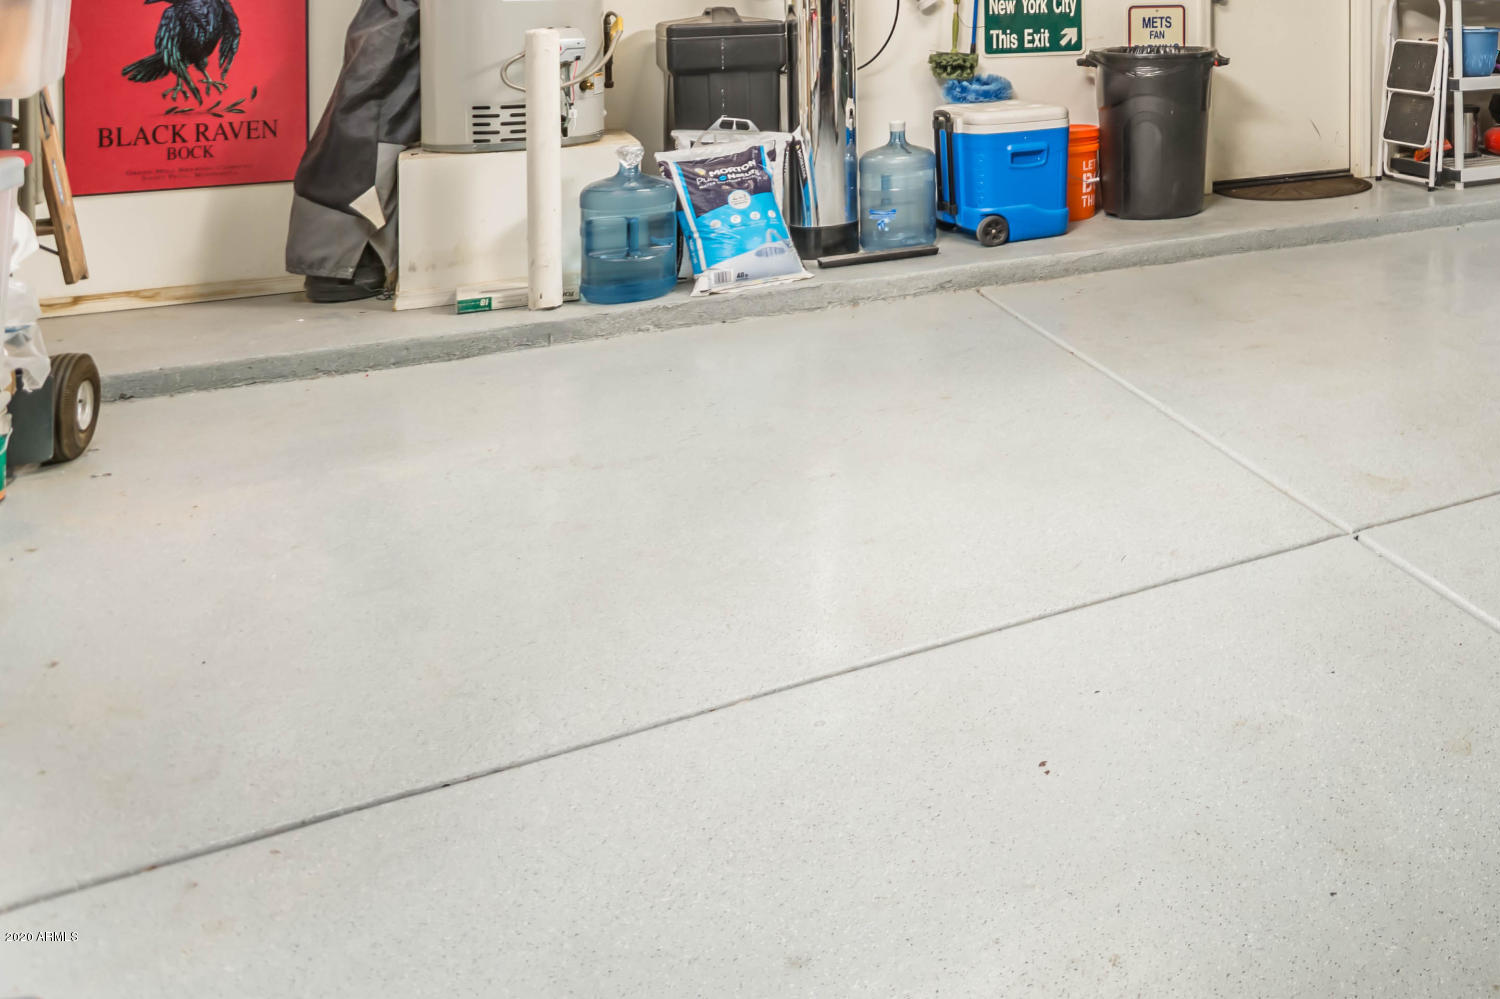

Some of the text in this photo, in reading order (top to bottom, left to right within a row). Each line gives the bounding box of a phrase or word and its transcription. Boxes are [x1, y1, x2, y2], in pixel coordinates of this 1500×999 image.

[1141, 16, 1172, 29] METS
[989, 28, 1050, 49] This Exit
[1149, 30, 1165, 39] FAN
[97, 119, 279, 149] BLACK RAVEN
[166, 144, 215, 161] BOCK
[708, 160, 757, 177] MORTON
